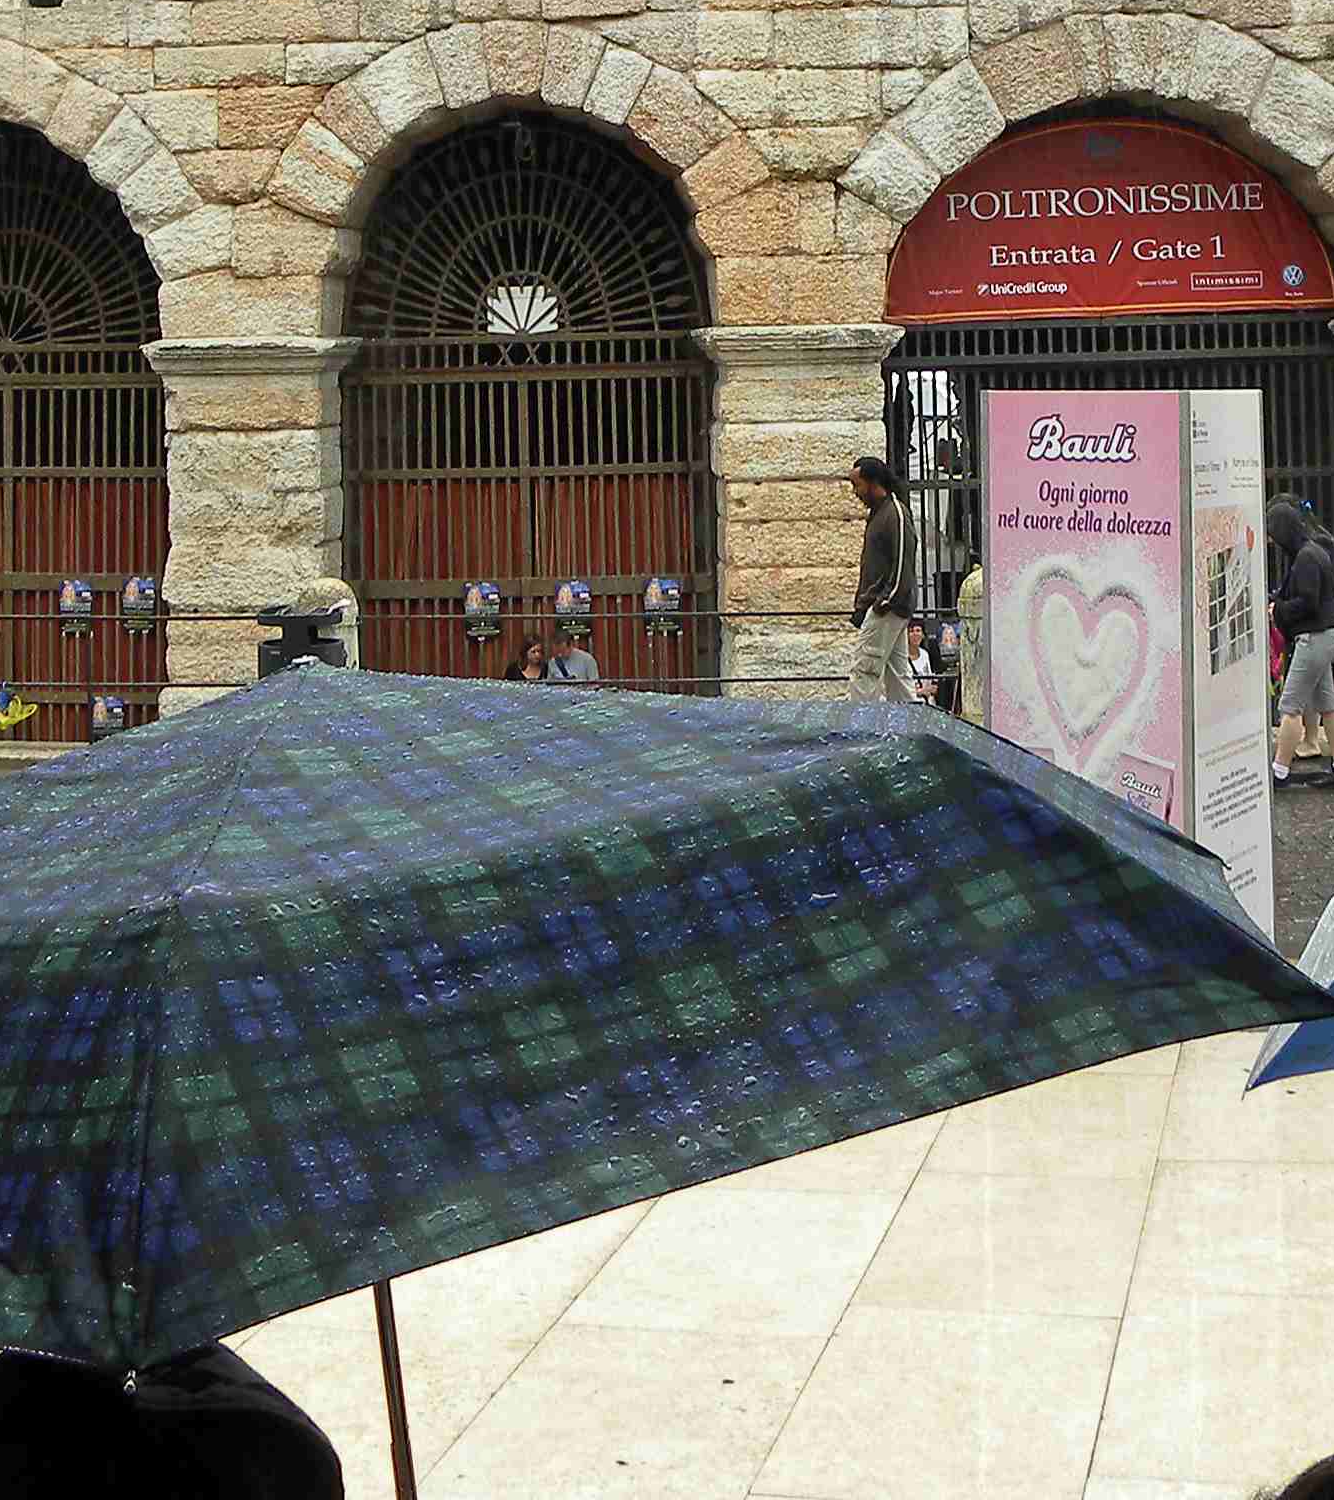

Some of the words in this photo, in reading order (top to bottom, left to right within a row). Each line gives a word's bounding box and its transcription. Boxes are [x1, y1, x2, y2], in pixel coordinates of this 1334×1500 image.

[946, 182, 1264, 222] POLTRONISSIME
[989, 244, 1096, 267] Entrata
[1107, 240, 1123, 266] /
[1133, 238, 1202, 261] Gate
[1210, 235, 1226, 259] 1
[1194, 275, 1259, 287] intimissimi
[1027, 414, 1138, 463] Bauli
[1038, 480, 1075, 508] Ogni
[1078, 482, 1129, 509] giorno
[998, 507, 1020, 529] nel
[1023, 513, 1064, 531] cuore
[1067, 510, 1103, 533] della
[1106, 511, 1172, 537] dolcezza
